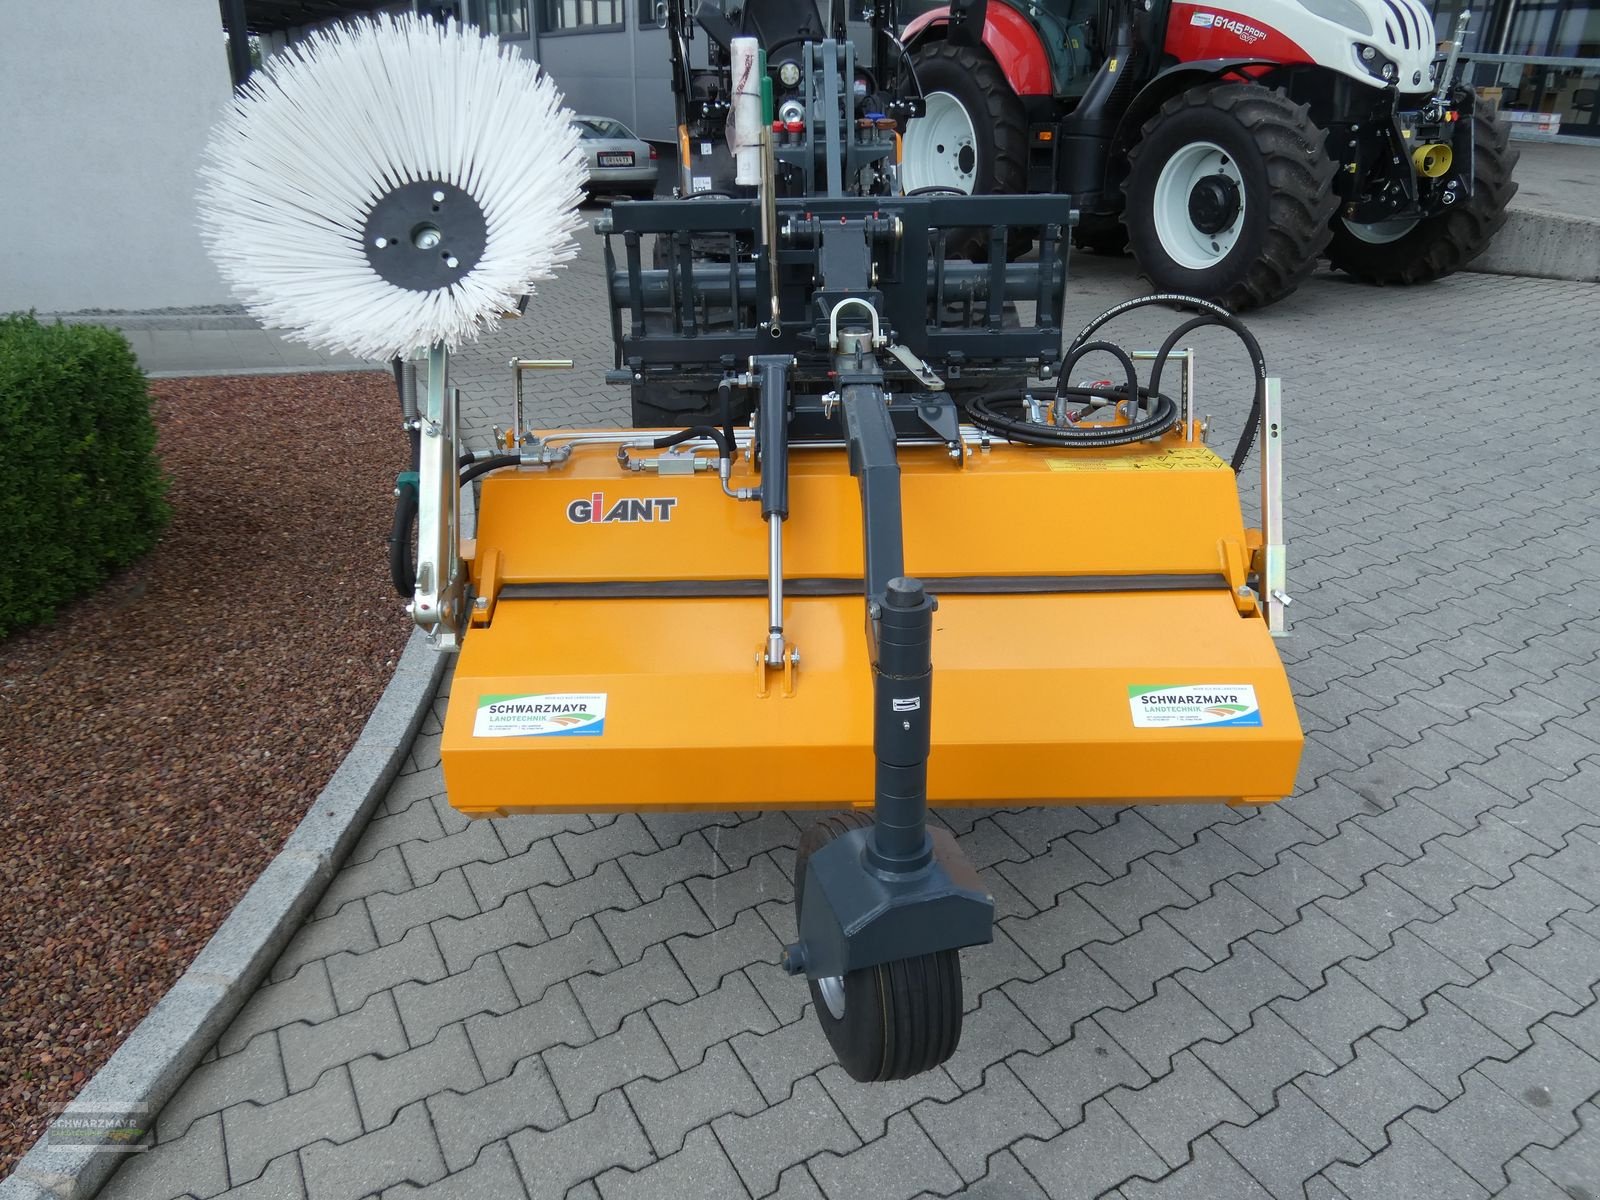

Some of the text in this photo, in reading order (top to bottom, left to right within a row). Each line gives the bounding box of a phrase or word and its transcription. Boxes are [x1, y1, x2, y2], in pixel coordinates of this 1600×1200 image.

[1214, 16, 1267, 40] 6145 PROFI
[1141, 695, 1238, 704] SCHWARZMAYR
[489, 704, 588, 714] SCHWARZMAYR
